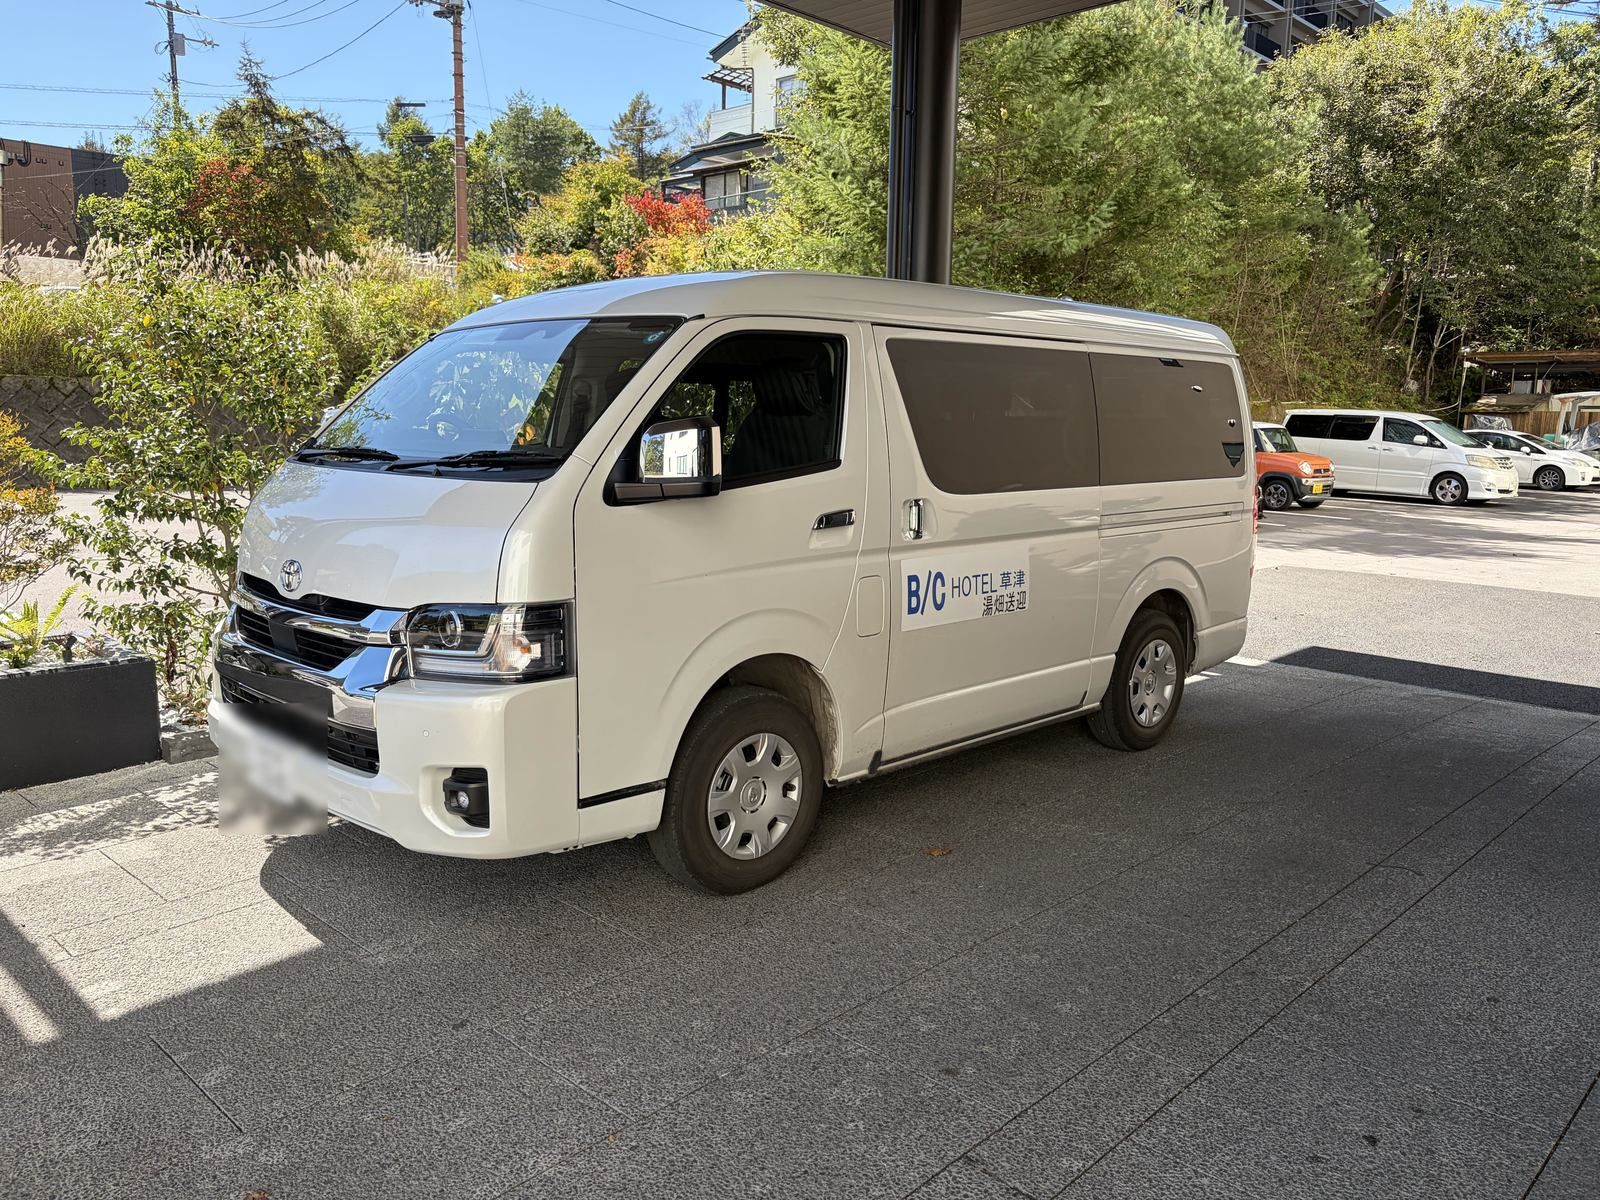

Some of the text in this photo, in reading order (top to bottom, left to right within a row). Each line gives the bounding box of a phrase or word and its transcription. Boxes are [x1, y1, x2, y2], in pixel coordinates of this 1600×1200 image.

[907, 569, 1026, 616] B/C HOTEL 草津
[982, 590, 1027, 617] 湯畑送迎
